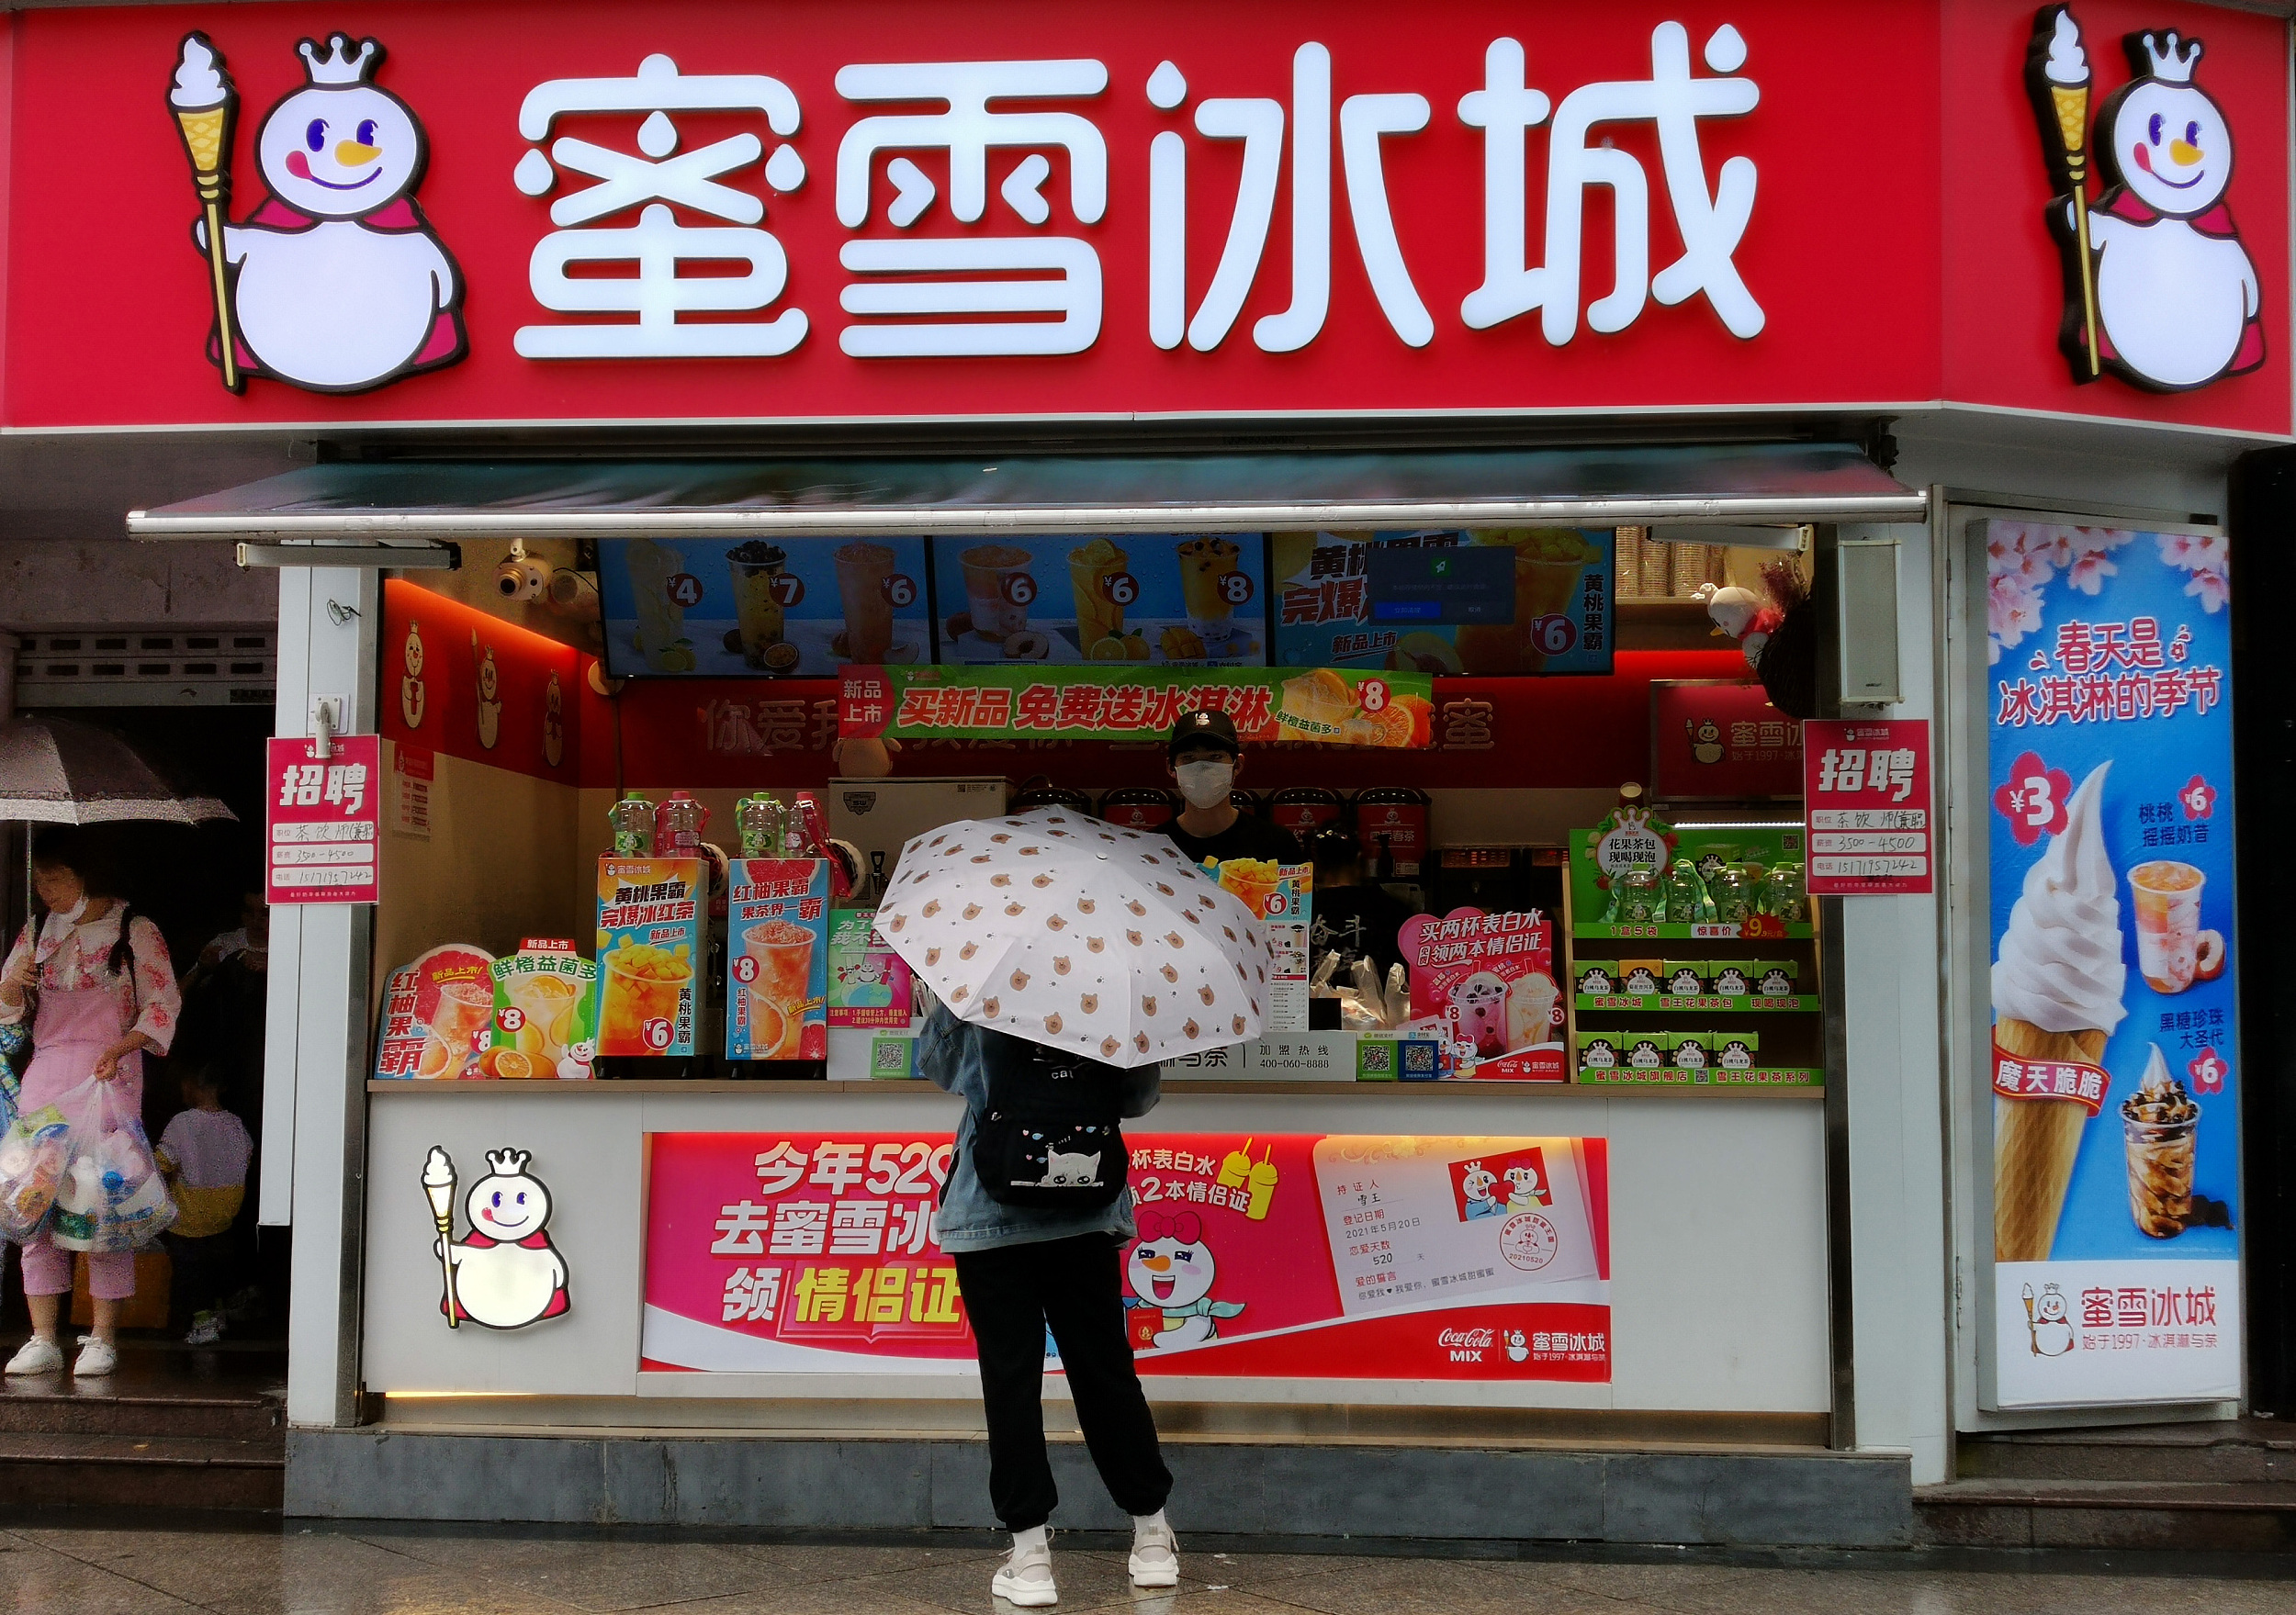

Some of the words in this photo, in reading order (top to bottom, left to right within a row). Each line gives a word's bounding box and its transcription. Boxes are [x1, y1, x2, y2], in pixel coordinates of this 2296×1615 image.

[512, 20, 1765, 358] 蜜雪冰城
[668, 577, 697, 603] ¥4
[770, 577, 798, 603] ¥7
[882, 577, 912, 604] ¥6
[1104, 576, 1133, 602] ¥6
[1219, 576, 1249, 601] ¥8
[1281, 578, 1367, 626] 完爆
[1582, 573, 1604, 652] 黄桃果霸
[1332, 632, 1397, 655] 新品上市
[1534, 619, 1567, 652] ¥6
[2054, 617, 2163, 673] 春天是
[843, 679, 883, 699] 新品
[1357, 680, 1384, 711] ¥8
[1998, 667, 2221, 725] 冰淇淋的季节
[843, 703, 883, 723] 上市
[897, 685, 1012, 729] 买新品
[1013, 684, 1275, 731] 免费送冰淇淋
[1275, 710, 1333, 735] 鲜橙益菌多
[1818, 748, 1916, 802] 招聘
[279, 763, 366, 814] 招聘
[2009, 777, 2054, 826] ¥3
[2138, 802, 2174, 824] 桃桃
[1816, 815, 1832, 824] 职位
[1609, 838, 1656, 850] 花果茶包
[1816, 838, 1833, 847] 薪资
[2143, 824, 2209, 847] 摇摇奶昔
[617, 863, 651, 875] 蜜雪冰城
[1608, 851, 1656, 863] 现喝现泡
[1817, 861, 1834, 870] 电话
[613, 880, 687, 905] 黄桃果霸
[732, 878, 812, 903] 红柚果霸
[1290, 880, 1300, 915] 黄桃果霸
[600, 900, 696, 929] 完爆冰红茶
[740, 897, 825, 922] 果茶界一霸
[649, 927, 686, 941] 新品上市
[837, 920, 874, 931] 为了
[1418, 907, 1544, 944] 买两杯表白水
[1696, 925, 1732, 936] 惊喜价
[526, 939, 569, 950] 新品上市
[1431, 932, 1543, 963] 领两本情侣证
[492, 955, 597, 982] 鲜橙益菌多
[732, 957, 756, 981] ¥8
[737, 988, 747, 1026] 红柚果霸
[1593, 997, 1642, 1008] 蜜雪冰城
[1660, 997, 1733, 1009] 雪王花果茶包
[1751, 998, 1800, 1009] 现喝现泡
[377, 971, 428, 1076] 红柚果霸
[499, 1008, 522, 1030] ¥8
[678, 988, 692, 1044] 黄桃果霸
[2159, 1008, 2224, 1033] 黑糖珍珠
[646, 1020, 669, 1048] ¥6
[2179, 1029, 2224, 1050] 大圣代
[1260, 1044, 1329, 1057] 加盟热线
[1259, 1059, 1329, 1069] 400-060-8888
[1595, 1071, 1687, 1082] 蜜雪冰城旗舰店
[1716, 1071, 1810, 1082] 雪王花果茶系列
[1337, 1179, 1380, 1195] 持证人
[1357, 1193, 1381, 1206] 雪王
[710, 1199, 939, 1255] 去蜜雪冰
[1343, 1208, 1385, 1226] 登记日期
[1345, 1217, 1422, 1239] 2021年5月20日
[1348, 1239, 1391, 1257] 恋爱天数
[1372, 1252, 1394, 1266] 520
[1509, 1252, 1544, 1264] 20210520
[1355, 1271, 1398, 1288] 爱的誓言
[2081, 1285, 2217, 1329] 蜜雪冰城
[1532, 1331, 1605, 1352] 蜜雪冰城
[1449, 1350, 1482, 1363] MIX
